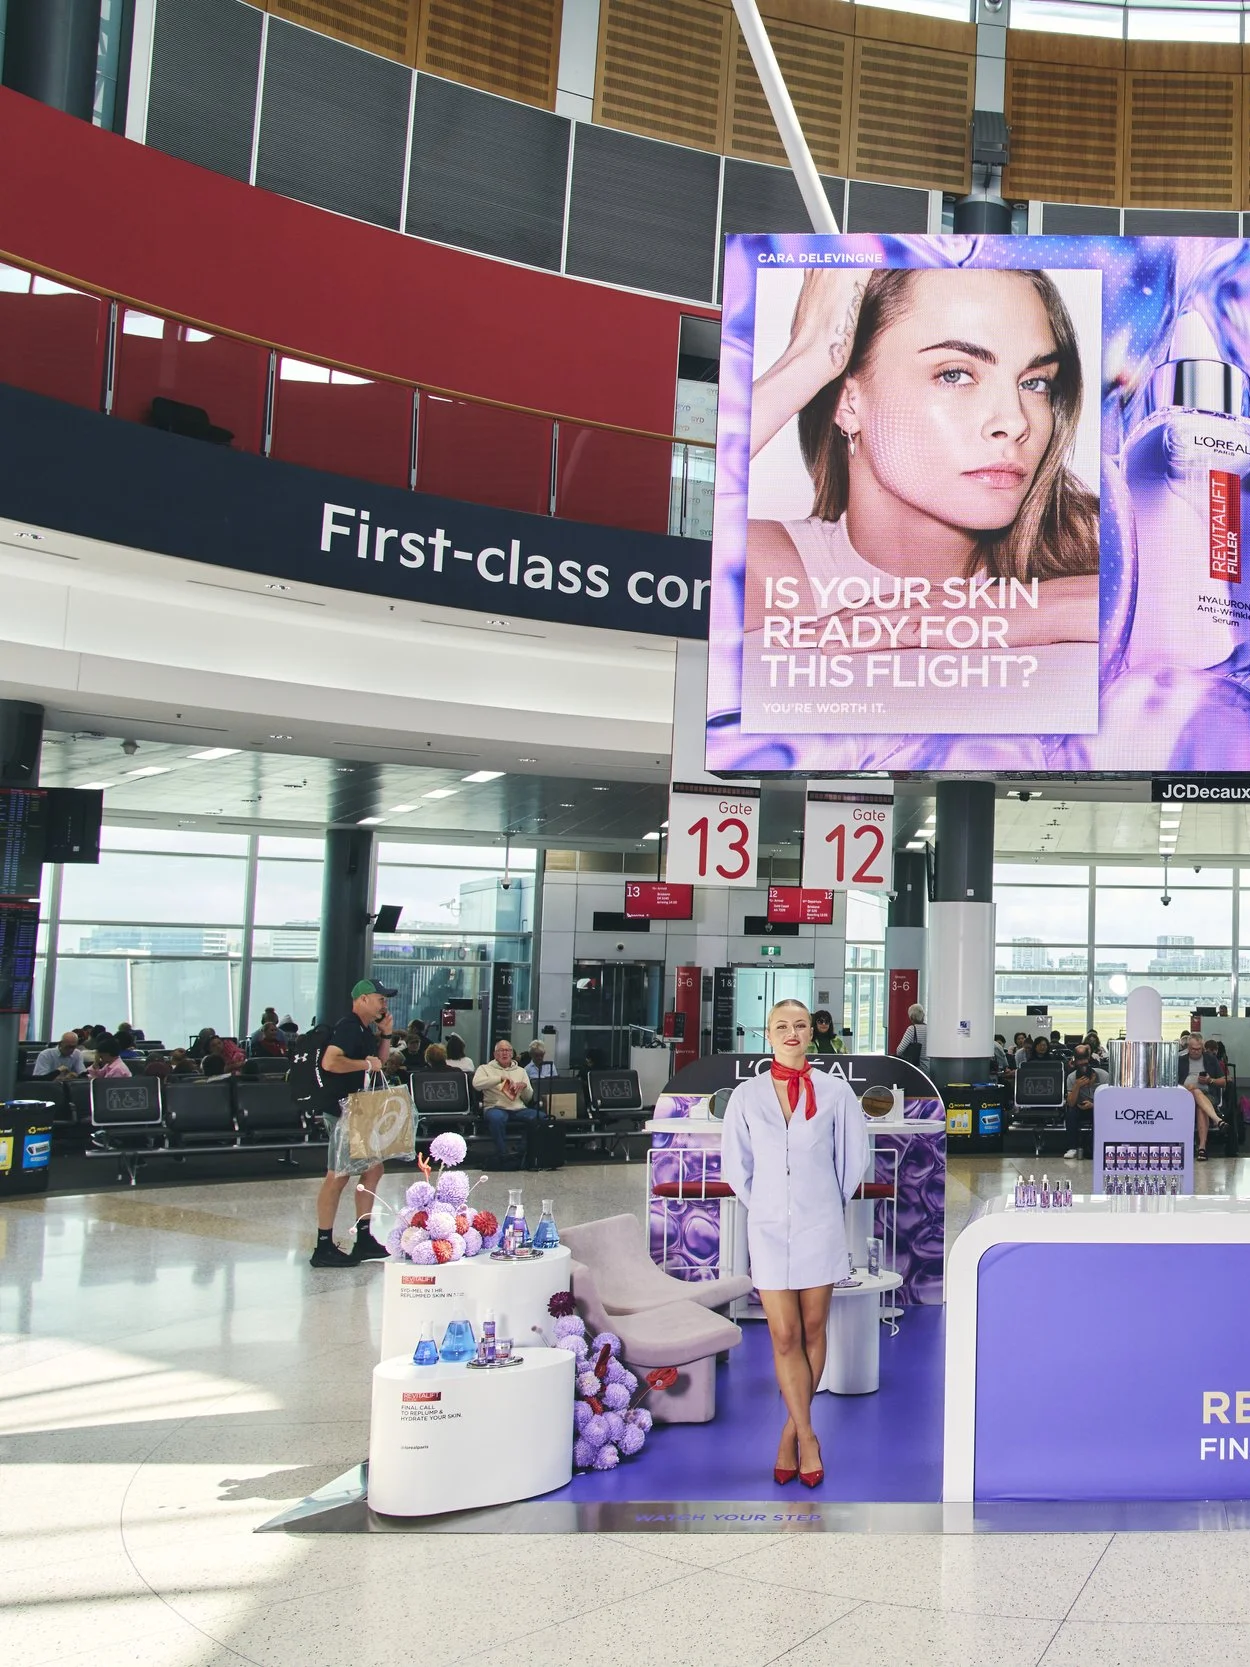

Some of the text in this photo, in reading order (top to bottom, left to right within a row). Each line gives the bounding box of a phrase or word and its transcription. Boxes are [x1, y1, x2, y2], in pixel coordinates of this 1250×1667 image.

[757, 253, 884, 264] CARA DELEVINGNE
[1211, 478, 1227, 574] REVITALIFT
[320, 503, 610, 599] First-class
[1227, 531, 1238, 575] FILLER
[764, 577, 1039, 610] IS YOUR SKIN
[1198, 595, 1250, 611] HYALURON
[1212, 615, 1240, 627] Serum
[763, 615, 1009, 649] READY FOR
[762, 654, 1039, 689] THIS FLIGHT?
[763, 702, 886, 714] YOU'RE WORTH IT.
[1162, 784, 1250, 799] JCDecaux
[718, 801, 753, 816] Gate
[853, 808, 886, 823] Gate
[687, 817, 751, 880] 13
[825, 824, 884, 884] 12
[627, 886, 641, 898] 13
[769, 890, 778, 898] 12
[824, 892, 833, 900] 12
[735, 1057, 867, 1082] L'AL
[1115, 1108, 1173, 1120] L'ORÉAL
[635, 1513, 822, 1522] WATCH YOUR STEP
